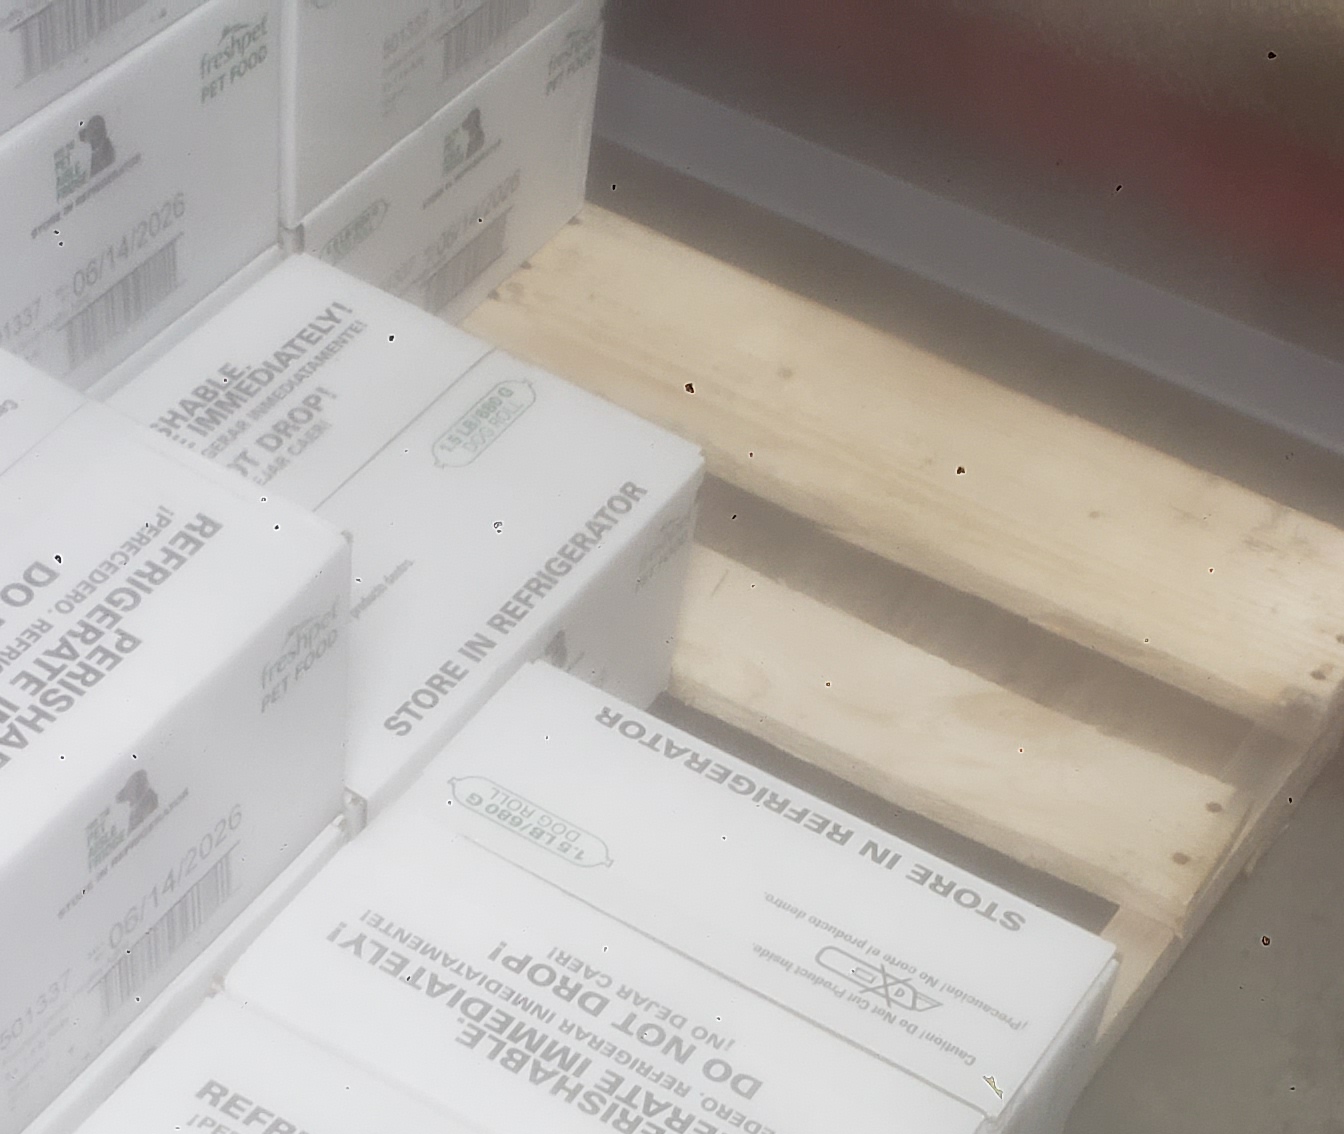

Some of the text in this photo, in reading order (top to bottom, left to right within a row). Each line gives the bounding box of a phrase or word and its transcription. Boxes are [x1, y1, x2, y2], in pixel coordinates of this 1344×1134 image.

[199, 12, 268, 80] freshpet
[201, 44, 268, 104] PET FOOD
[72, 191, 186, 297] 06/14/2026
[187, 301, 353, 439] IMMEDIATELY!
[247, 319, 367, 421] INMEDIATAMENTE!
[255, 386, 338, 452] DROP!
[8, 511, 224, 698] REFRIGERATE
[46, 503, 175, 616] ¡PERECEDERO.
[384, 479, 649, 738] STORE IN REFRIGERATOR
[259, 593, 342, 690] freshpet
[260, 627, 340, 715] PET FOOD
[485, 803, 586, 861] 1.5 LB/680
[489, 786, 582, 843] DOG ROLL
[593, 704, 1028, 934] STORE IN REFRIGERATOR
[108, 803, 243, 950] 06/14/2026
[358, 907, 559, 1034] INMEDIATAMENTE!
[807, 914, 868, 952] producto
[324, 920, 593, 1079] IMMEDIATELY!
[485, 939, 766, 1101] DO NOT DROP!
[546, 945, 737, 1052] ¡NO DEJAR CAER!
[792, 964, 978, 1067] Caution! Product
[557, 1017, 693, 1099] REFRIGERAR
